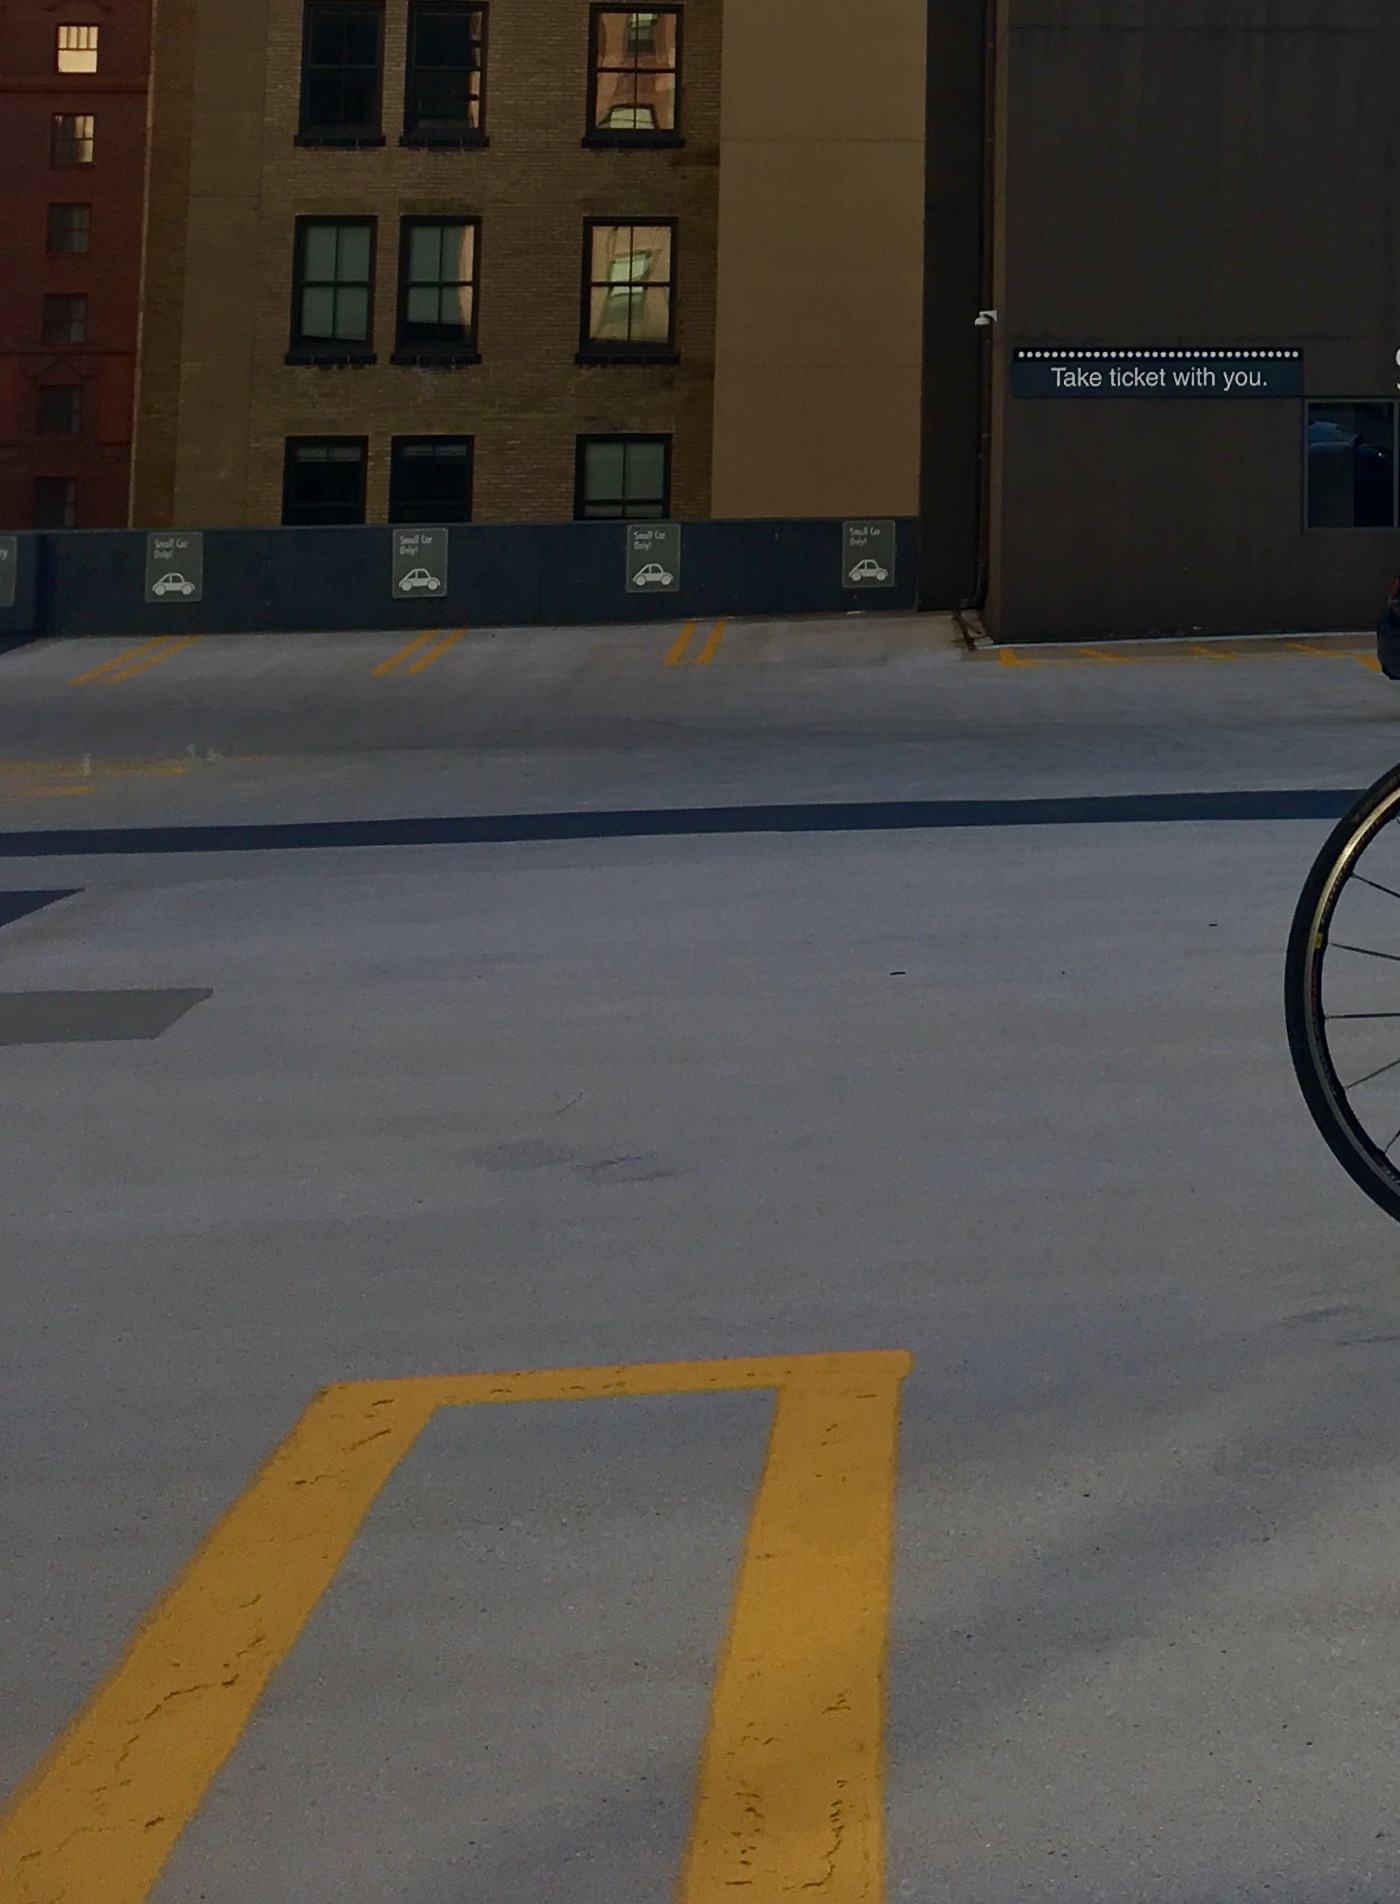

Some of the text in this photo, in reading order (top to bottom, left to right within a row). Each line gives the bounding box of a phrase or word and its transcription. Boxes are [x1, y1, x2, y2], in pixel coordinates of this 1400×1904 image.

[1050, 366, 1269, 392] Take ticket with you.
